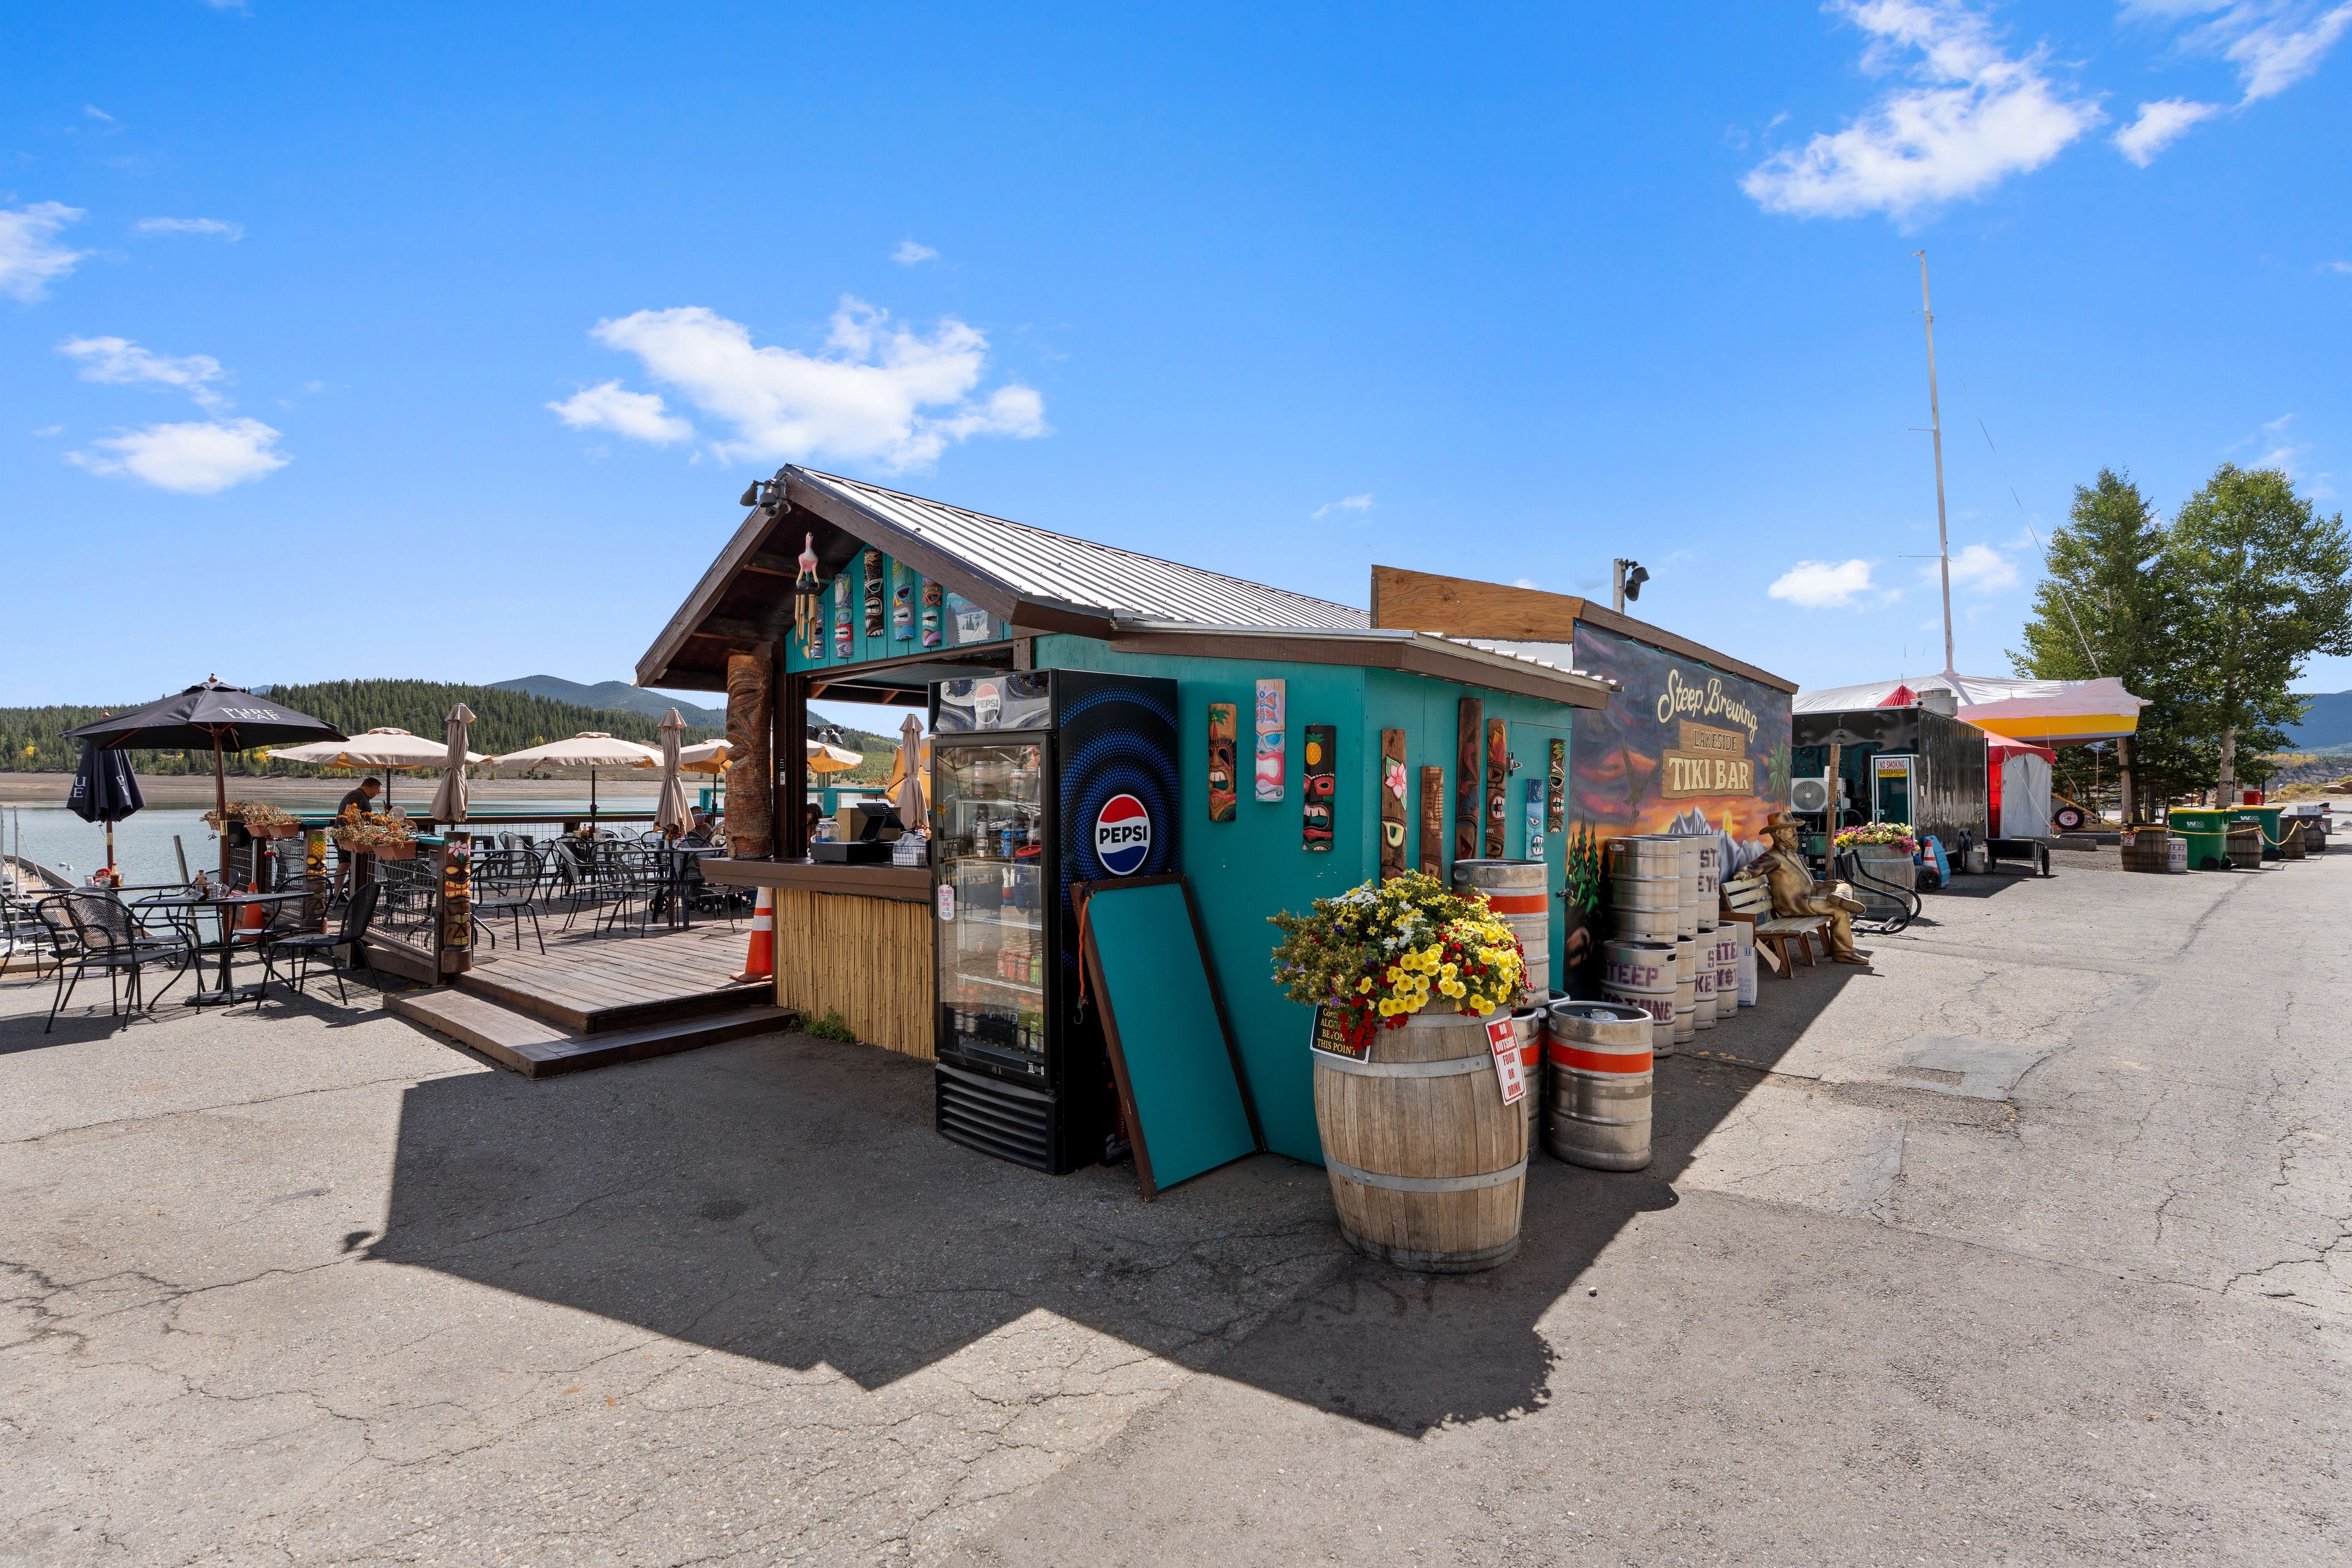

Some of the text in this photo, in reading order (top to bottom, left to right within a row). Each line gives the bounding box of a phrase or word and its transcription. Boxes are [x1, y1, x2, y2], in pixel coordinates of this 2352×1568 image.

[976, 699, 998, 709] PEPSI
[1657, 669, 1758, 744] Steep Brewing
[1694, 729, 1737, 752] LAKESIDE
[1669, 757, 1749, 791] TIKI BAR
[1099, 824, 1147, 844] PEPSI
[1322, 1028, 1345, 1042] BEYON
[1499, 1023, 1507, 1035] NO
[1317, 1038, 1356, 1055] THIS POINT
[1495, 1036, 1515, 1052] OUTSIDE
[1502, 1052, 1515, 1066] FOOD
[1508, 1068, 1515, 1080] OR
[1507, 1080, 1521, 1096] DRINK
